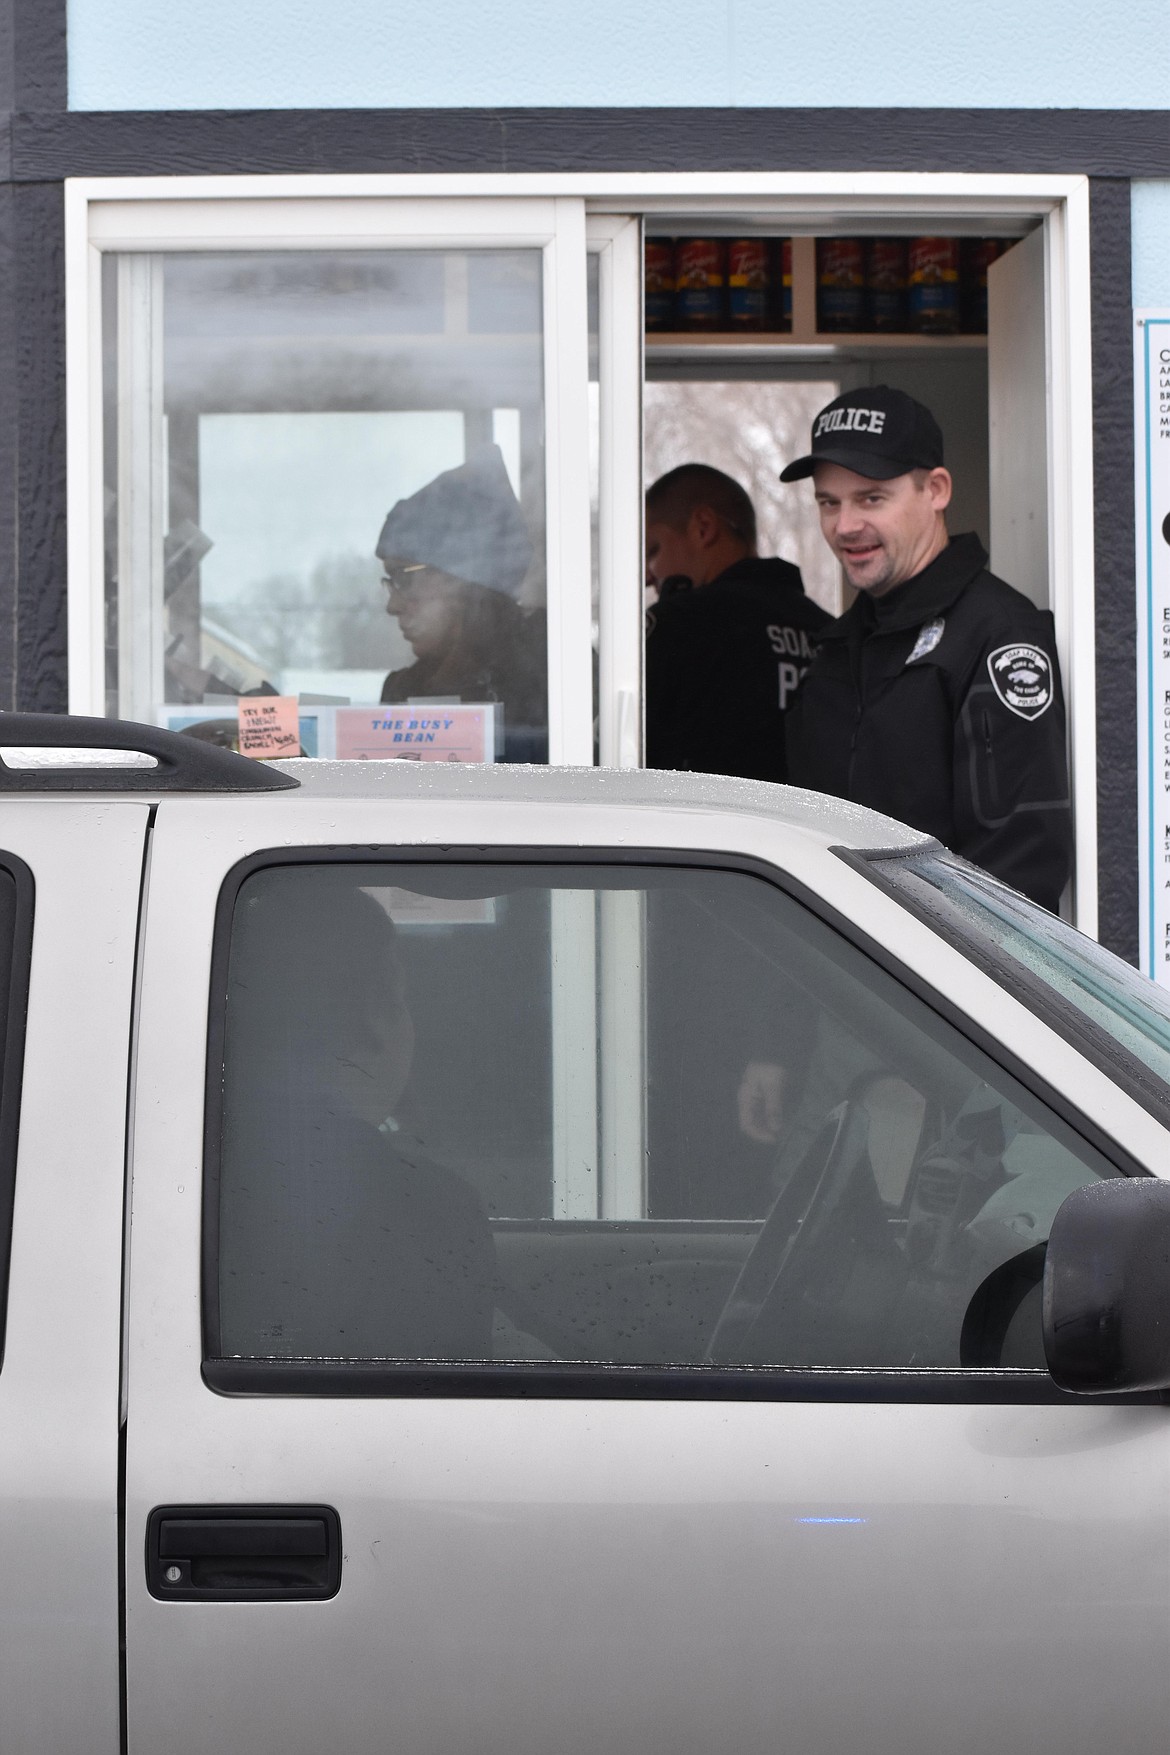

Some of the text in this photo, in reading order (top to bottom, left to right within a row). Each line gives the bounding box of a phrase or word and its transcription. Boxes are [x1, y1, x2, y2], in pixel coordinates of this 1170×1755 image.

[815, 408, 886, 438] POLICE
[766, 624, 823, 659] SOA
[243, 708, 257, 717] TRY
[372, 719, 453, 730] THE BUSY
[392, 732, 436, 743] BEAN
